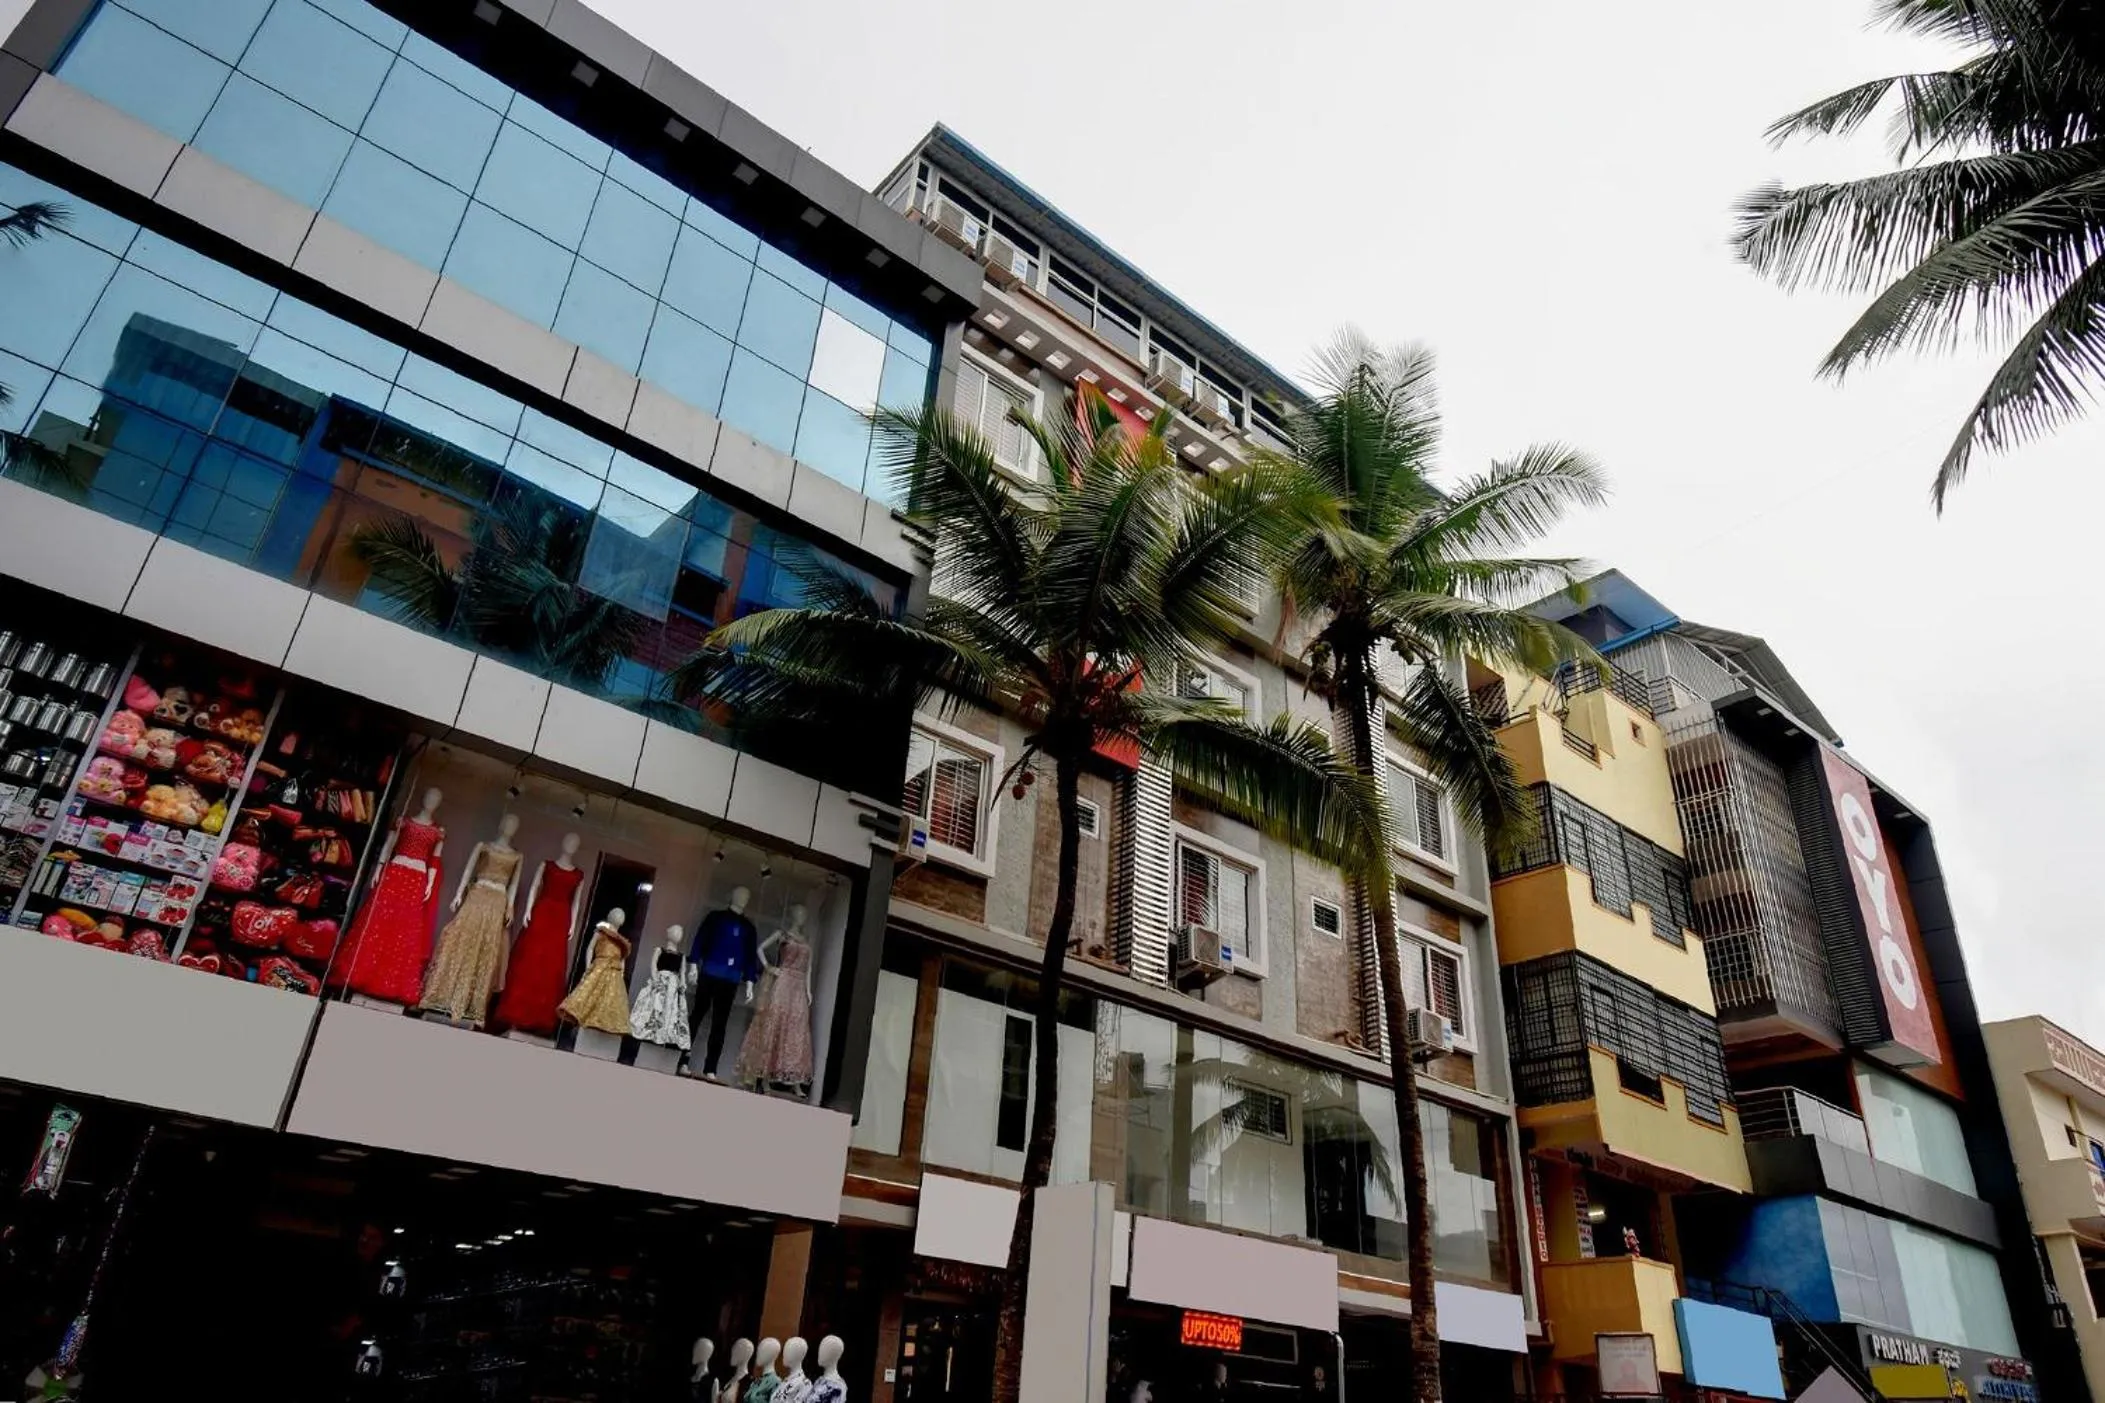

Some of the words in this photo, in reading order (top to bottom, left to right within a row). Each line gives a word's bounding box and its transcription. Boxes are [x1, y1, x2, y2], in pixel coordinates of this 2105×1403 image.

[1841, 791, 1917, 1011] OYO
[1185, 1319, 1240, 1344] UPTO50%
[1873, 1335, 1930, 1365] PRATHAM
